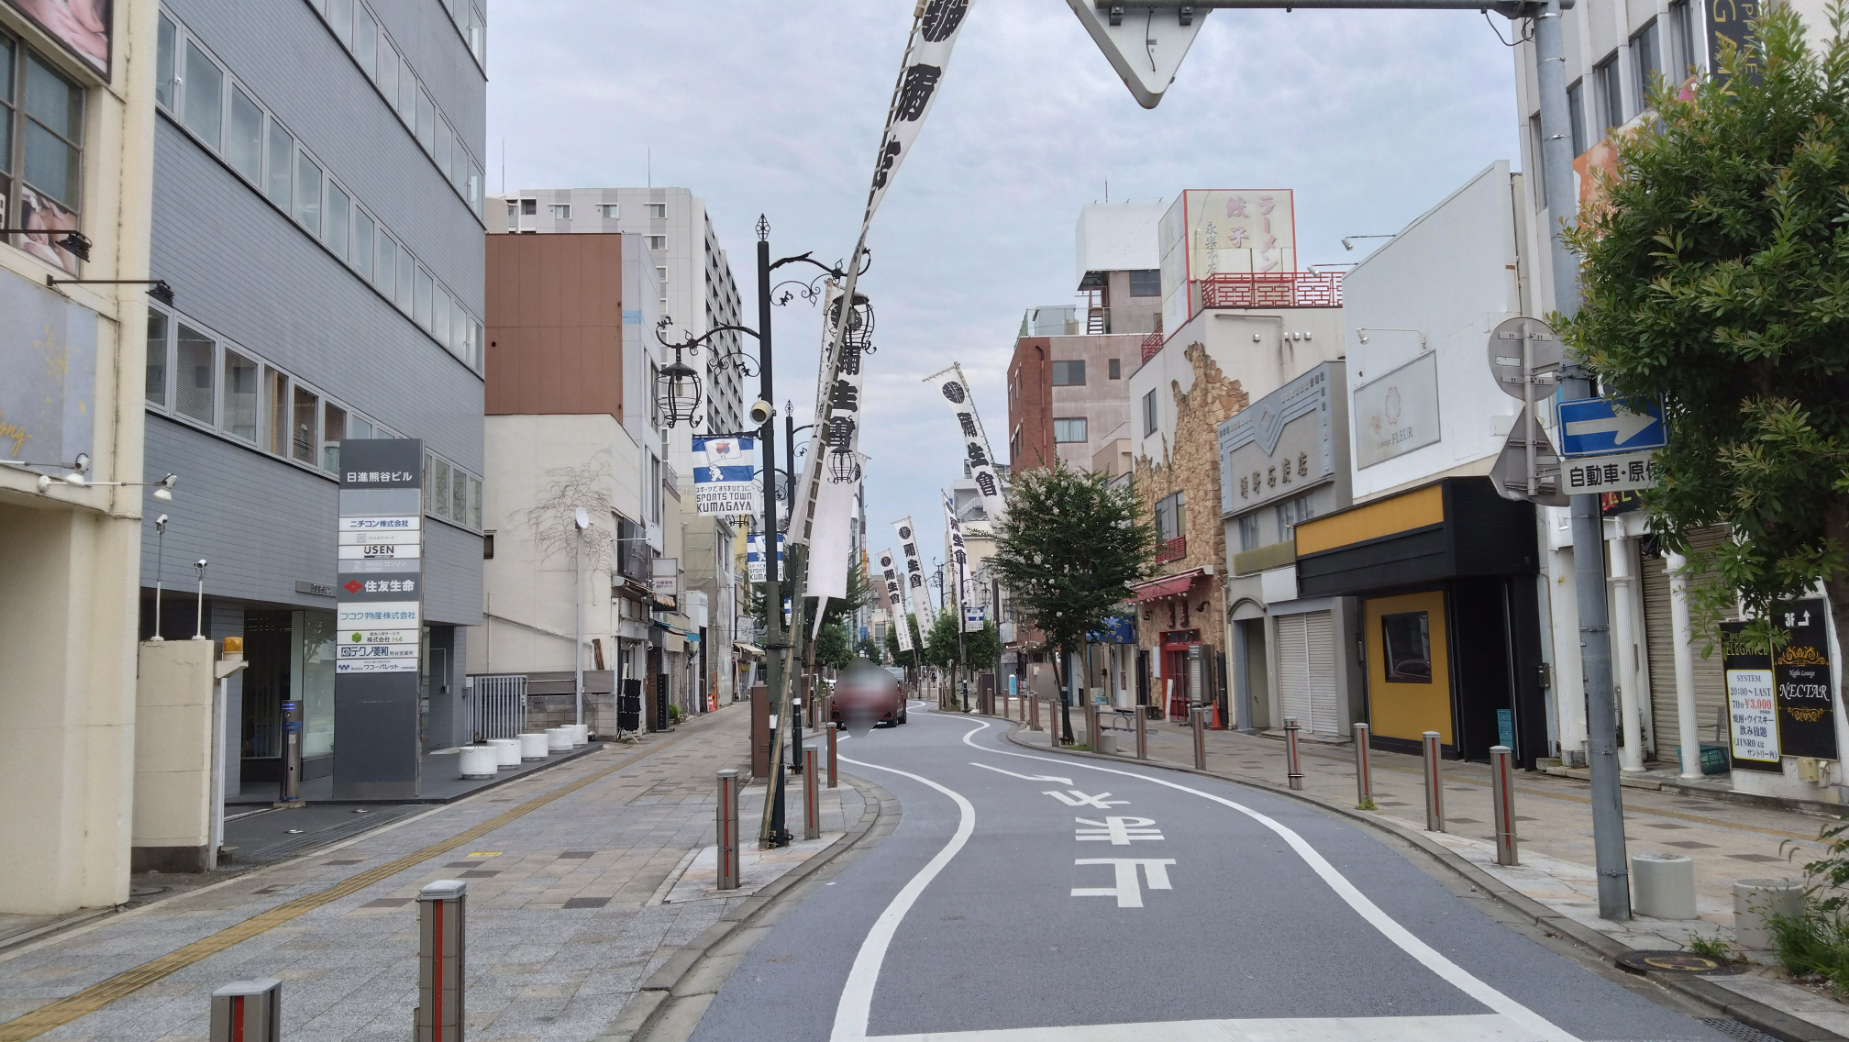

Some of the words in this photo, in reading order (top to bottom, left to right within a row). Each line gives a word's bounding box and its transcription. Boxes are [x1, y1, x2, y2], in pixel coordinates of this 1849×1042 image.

[1225, 195, 1250, 249] 餃子
[1257, 194, 1279, 273] ラーメン
[1391, 426, 1414, 445] FLEUR
[347, 471, 413, 483] 日進熊谷ビル
[697, 492, 727, 503] SPORTS
[730, 492, 752, 501] TOWN
[697, 501, 752, 513] KUMAGAYA
[350, 520, 409, 528] ニチコン株式会社
[364, 545, 394, 555] USEN
[365, 580, 415, 592] 住友生命
[1784, 612, 1795, 627] 3F
[1737, 674, 1761, 683] SYSTEM
[1779, 682, 1830, 701] NECTAR
[1740, 725, 1768, 738] 飲み放題
